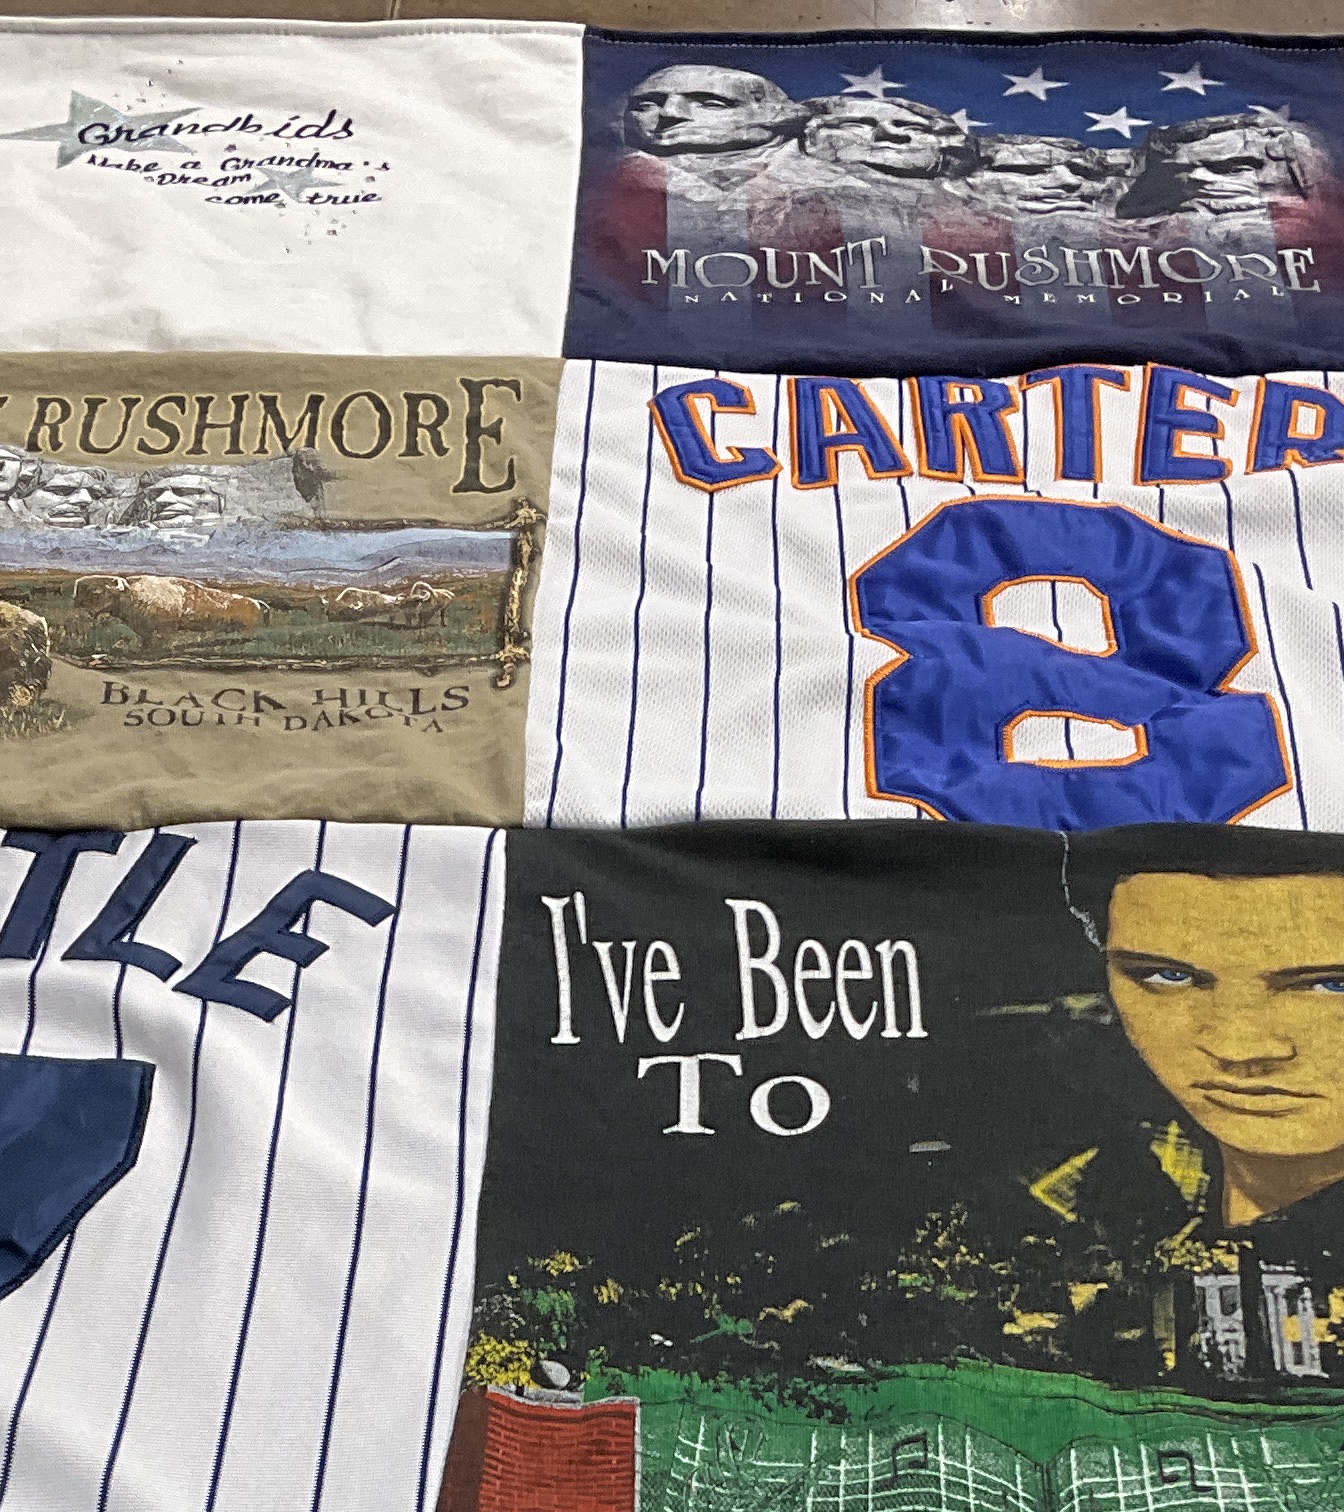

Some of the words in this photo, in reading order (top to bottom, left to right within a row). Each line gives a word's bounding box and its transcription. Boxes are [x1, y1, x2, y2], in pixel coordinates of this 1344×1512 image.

[156, 172, 252, 187] Dream
[179, 160, 202, 170] a
[205, 192, 281, 205] come
[306, 192, 383, 205] true
[641, 236, 888, 289] MOUNT
[918, 244, 1321, 292] RUSHMORE
[684, 278, 953, 304] NATIONAL
[1003, 285, 1286, 305] MEMORIAL
[27, 375, 526, 496] RUSHMORE
[850, 494, 1293, 832] 8
[100, 680, 287, 714] BLACK
[312, 685, 471, 716] HILLS
[123, 706, 264, 728] SOUTH
[283, 706, 444, 734] DAKOTA
[541, 891, 686, 1045] I've
[724, 898, 930, 1041] Been
[637, 1053, 832, 1136] To
